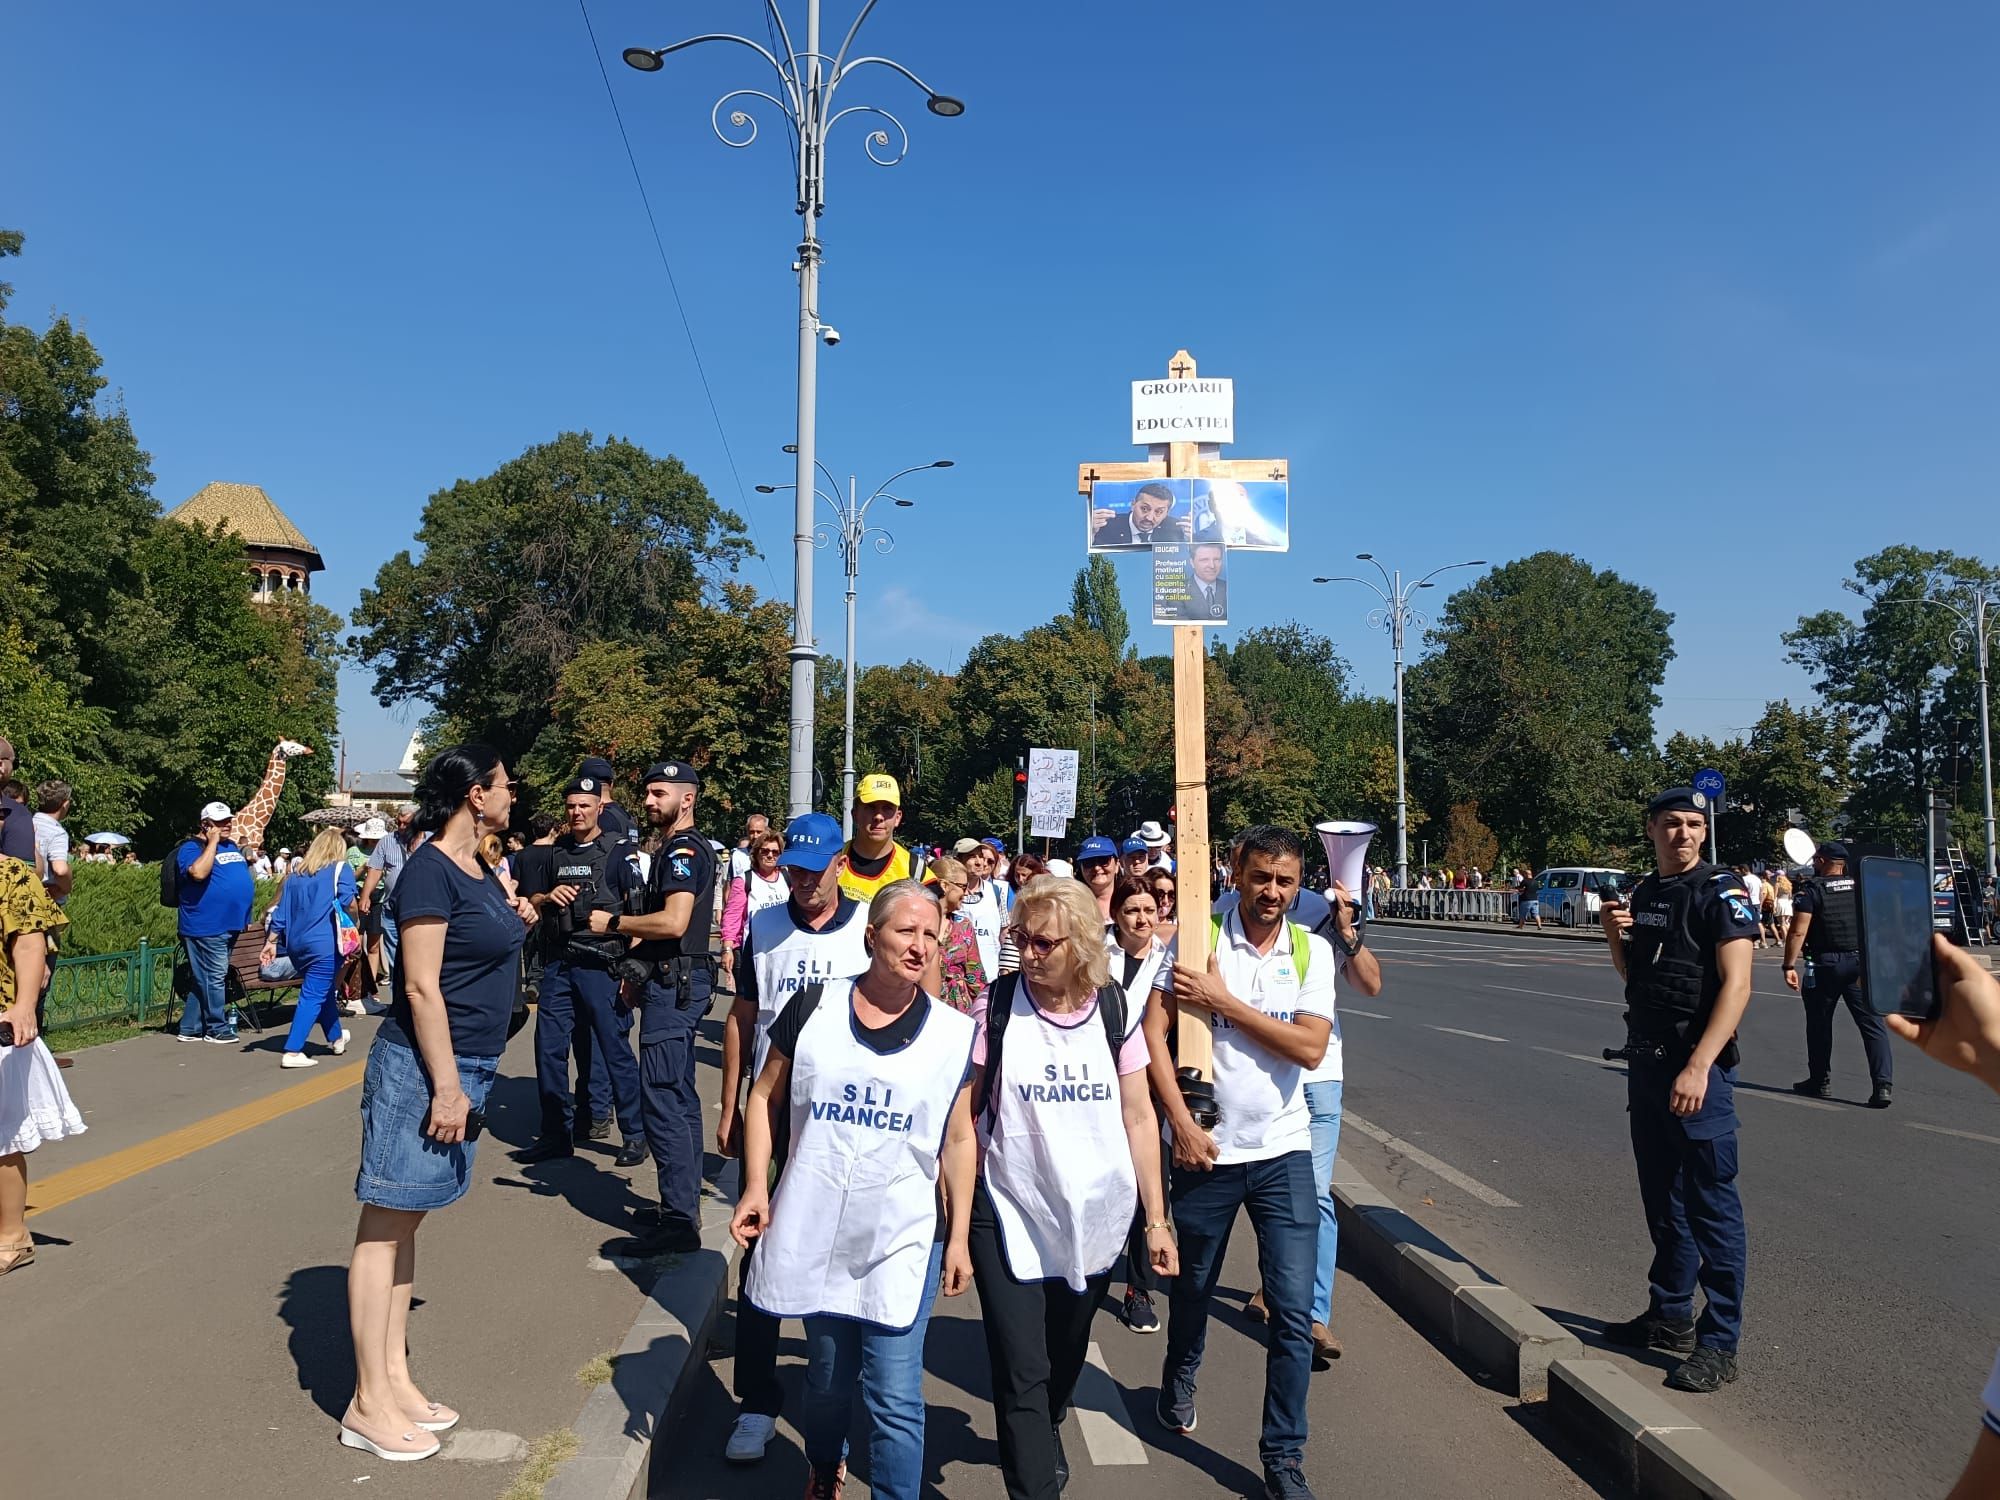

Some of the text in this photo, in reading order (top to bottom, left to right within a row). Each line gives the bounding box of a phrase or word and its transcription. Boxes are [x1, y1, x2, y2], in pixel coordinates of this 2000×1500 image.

[1141, 382, 1223, 396] GROPARII
[1136, 416, 1229, 431] EDUCAȚIEI
[792, 834, 820, 845] FSLI
[1018, 1082, 1112, 1103] VRANCEA
[811, 1101, 913, 1132] VRANCEA
